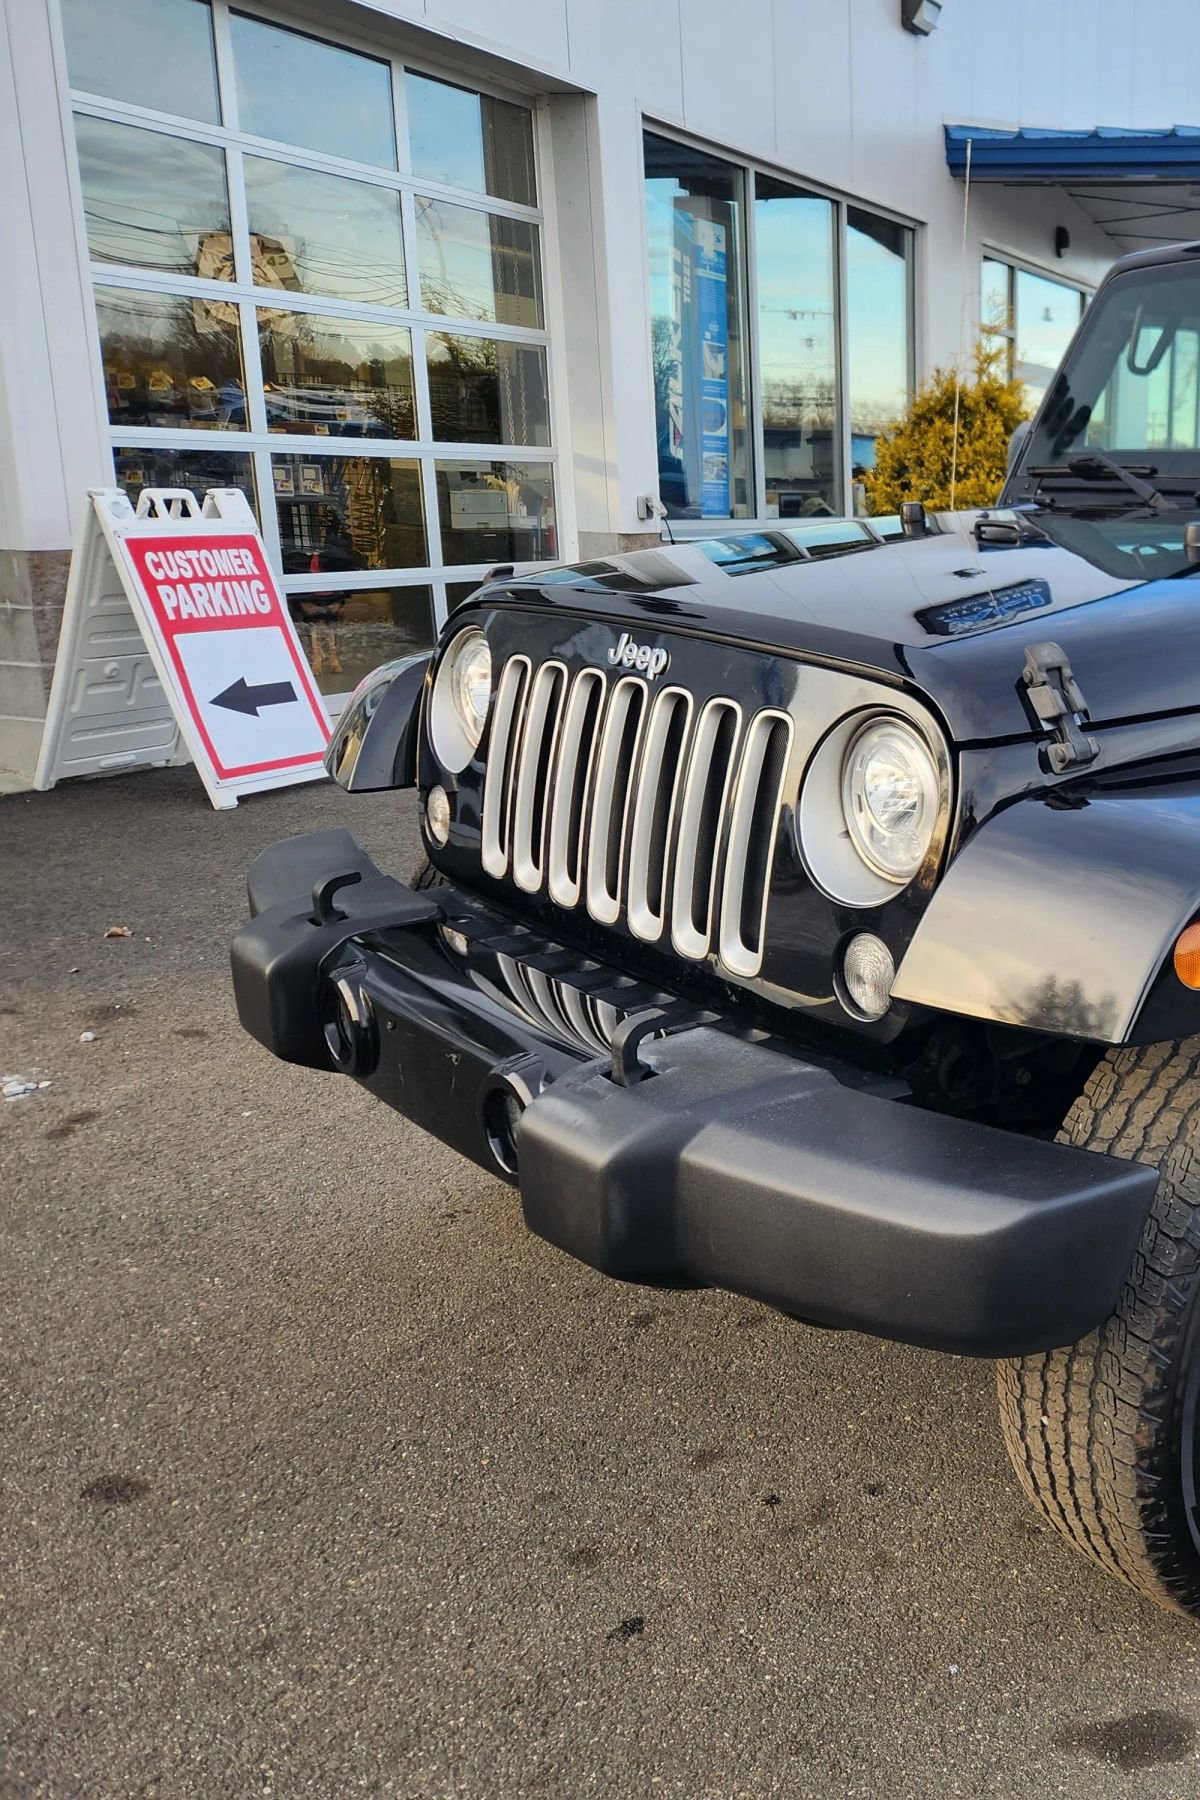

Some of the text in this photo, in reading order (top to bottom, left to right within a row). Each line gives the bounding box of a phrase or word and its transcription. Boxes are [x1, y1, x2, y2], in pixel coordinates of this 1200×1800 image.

[683, 254, 691, 304] TIRES
[144, 548, 260, 580] CUSTOMER
[156, 580, 272, 621] PARKING
[607, 633, 671, 681] Jeep
